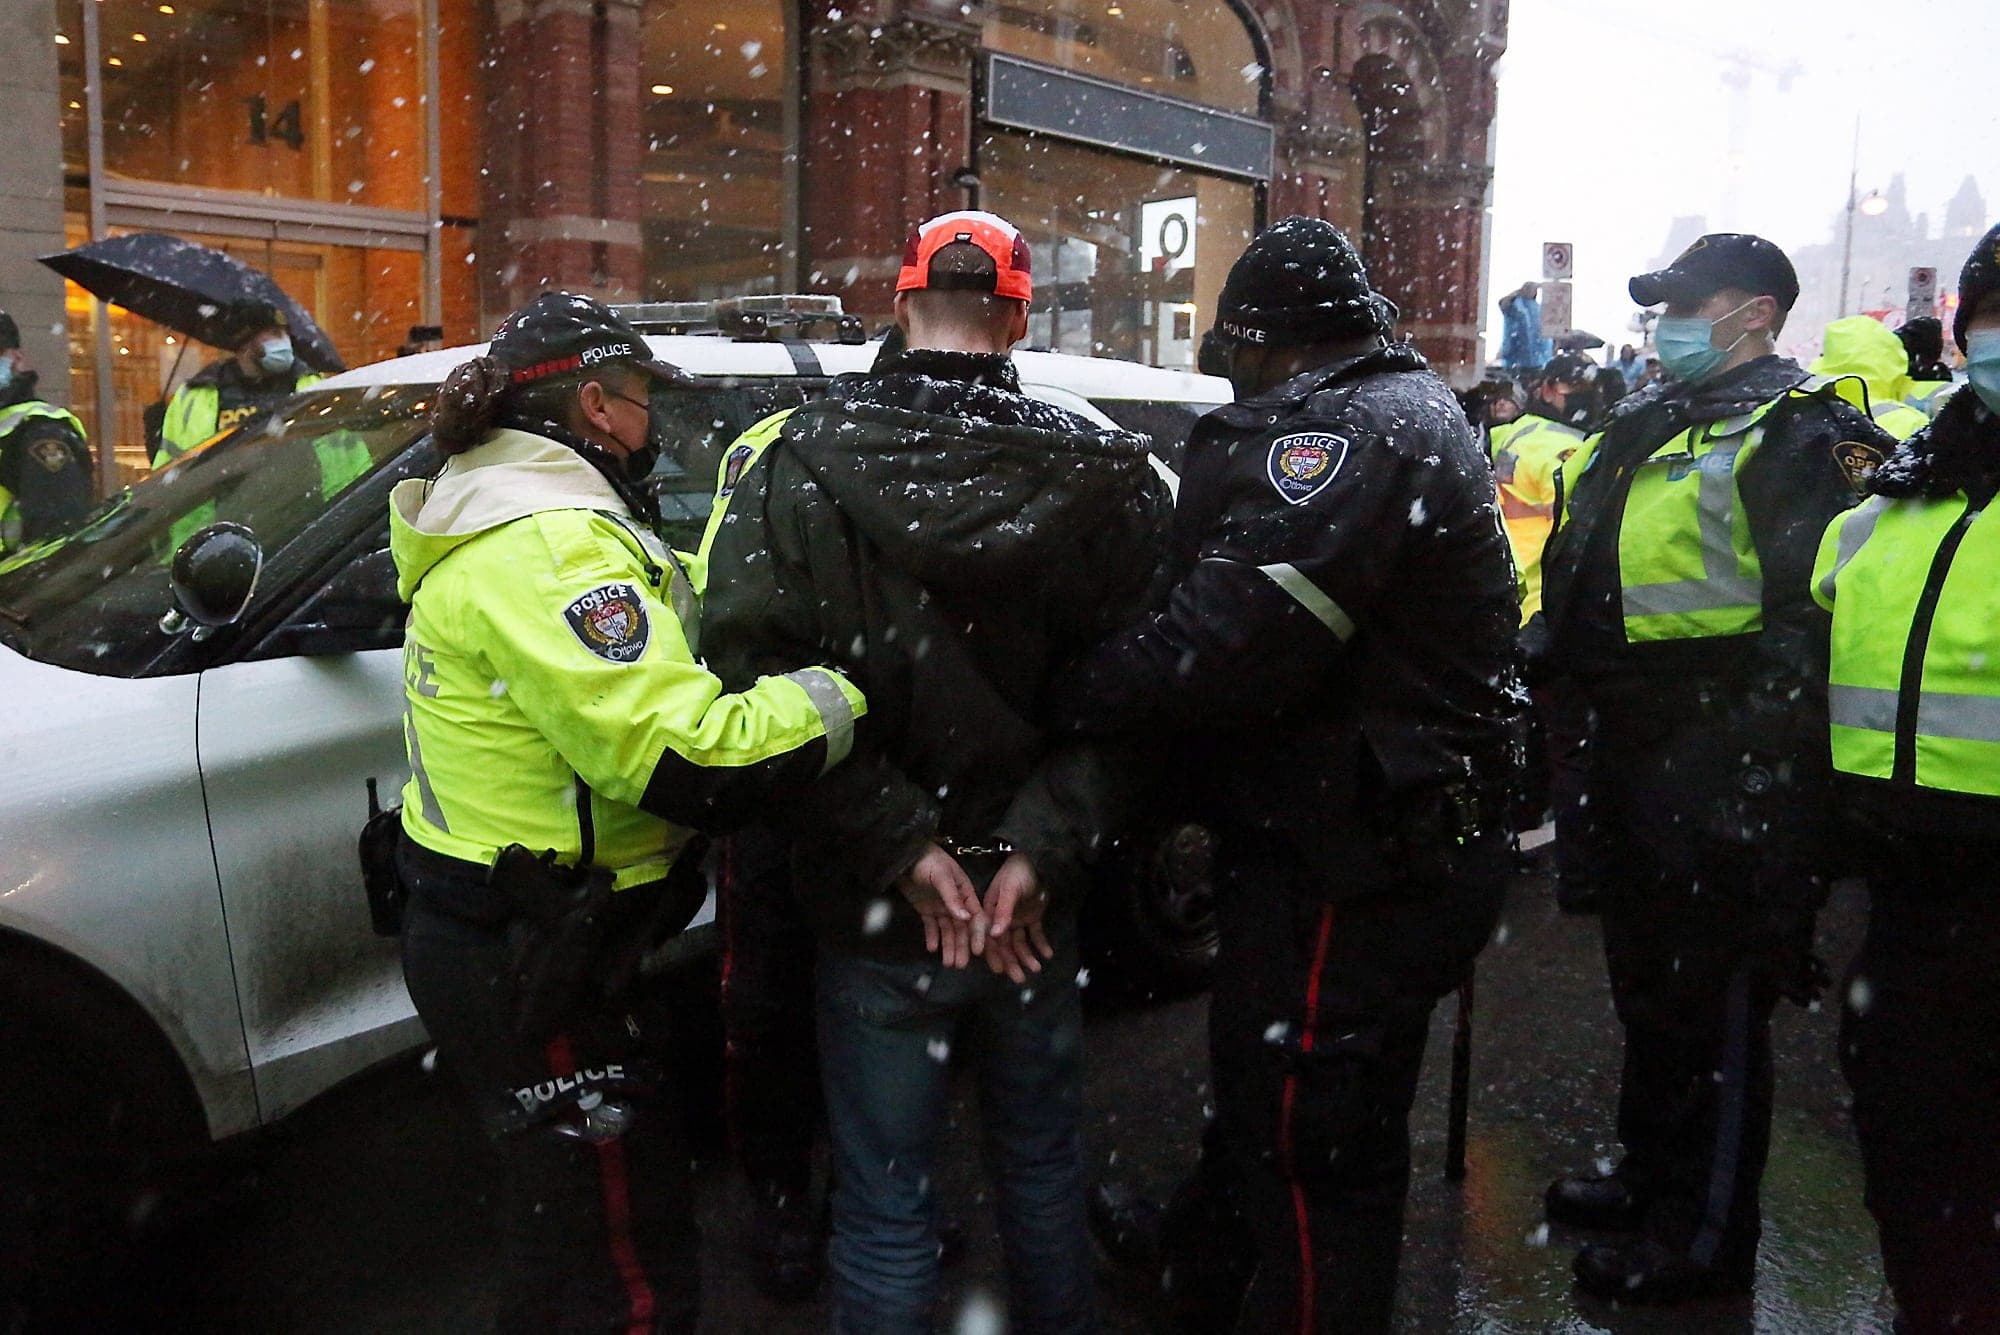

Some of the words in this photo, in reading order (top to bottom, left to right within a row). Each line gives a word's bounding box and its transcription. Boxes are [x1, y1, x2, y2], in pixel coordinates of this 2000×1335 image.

[242, 95, 304, 151] 14
[1223, 321, 1266, 343] POLICE
[582, 343, 632, 365] POLICE
[1283, 437, 1337, 451] POLICE
[1845, 455, 1876, 468] OPP
[515, 1064, 625, 1114] POLICE
